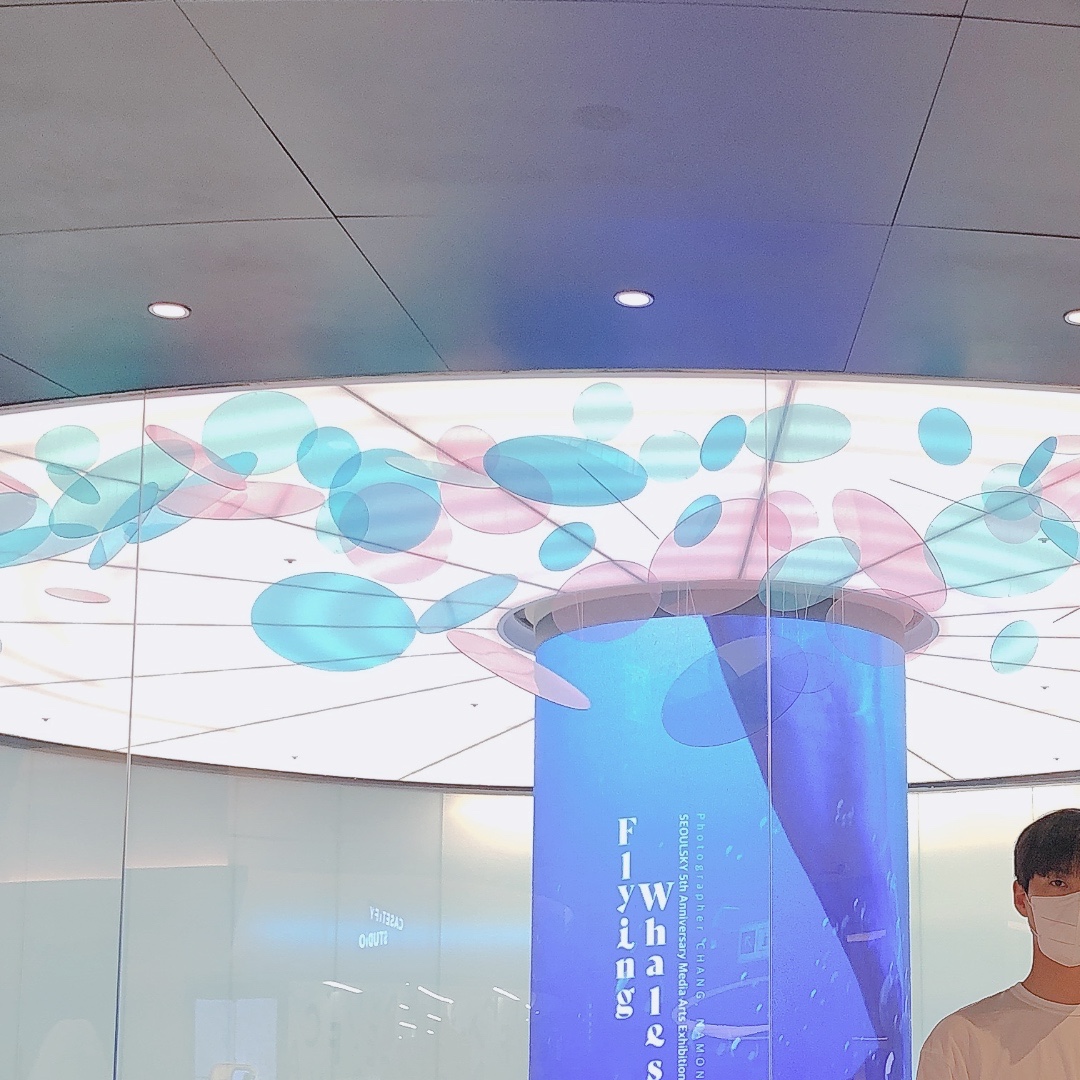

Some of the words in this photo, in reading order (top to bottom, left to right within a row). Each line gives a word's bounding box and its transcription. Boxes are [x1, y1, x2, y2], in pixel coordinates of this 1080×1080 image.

[678, 813, 689, 871] SEOULSKY
[678, 874, 689, 892] 5th
[615, 816, 638, 1020] Flying
[677, 895, 689, 960] Anniversary
[678, 962, 689, 996] Media
[678, 998, 689, 1022] Arts
[677, 1024, 688, 1080] Exhibition
